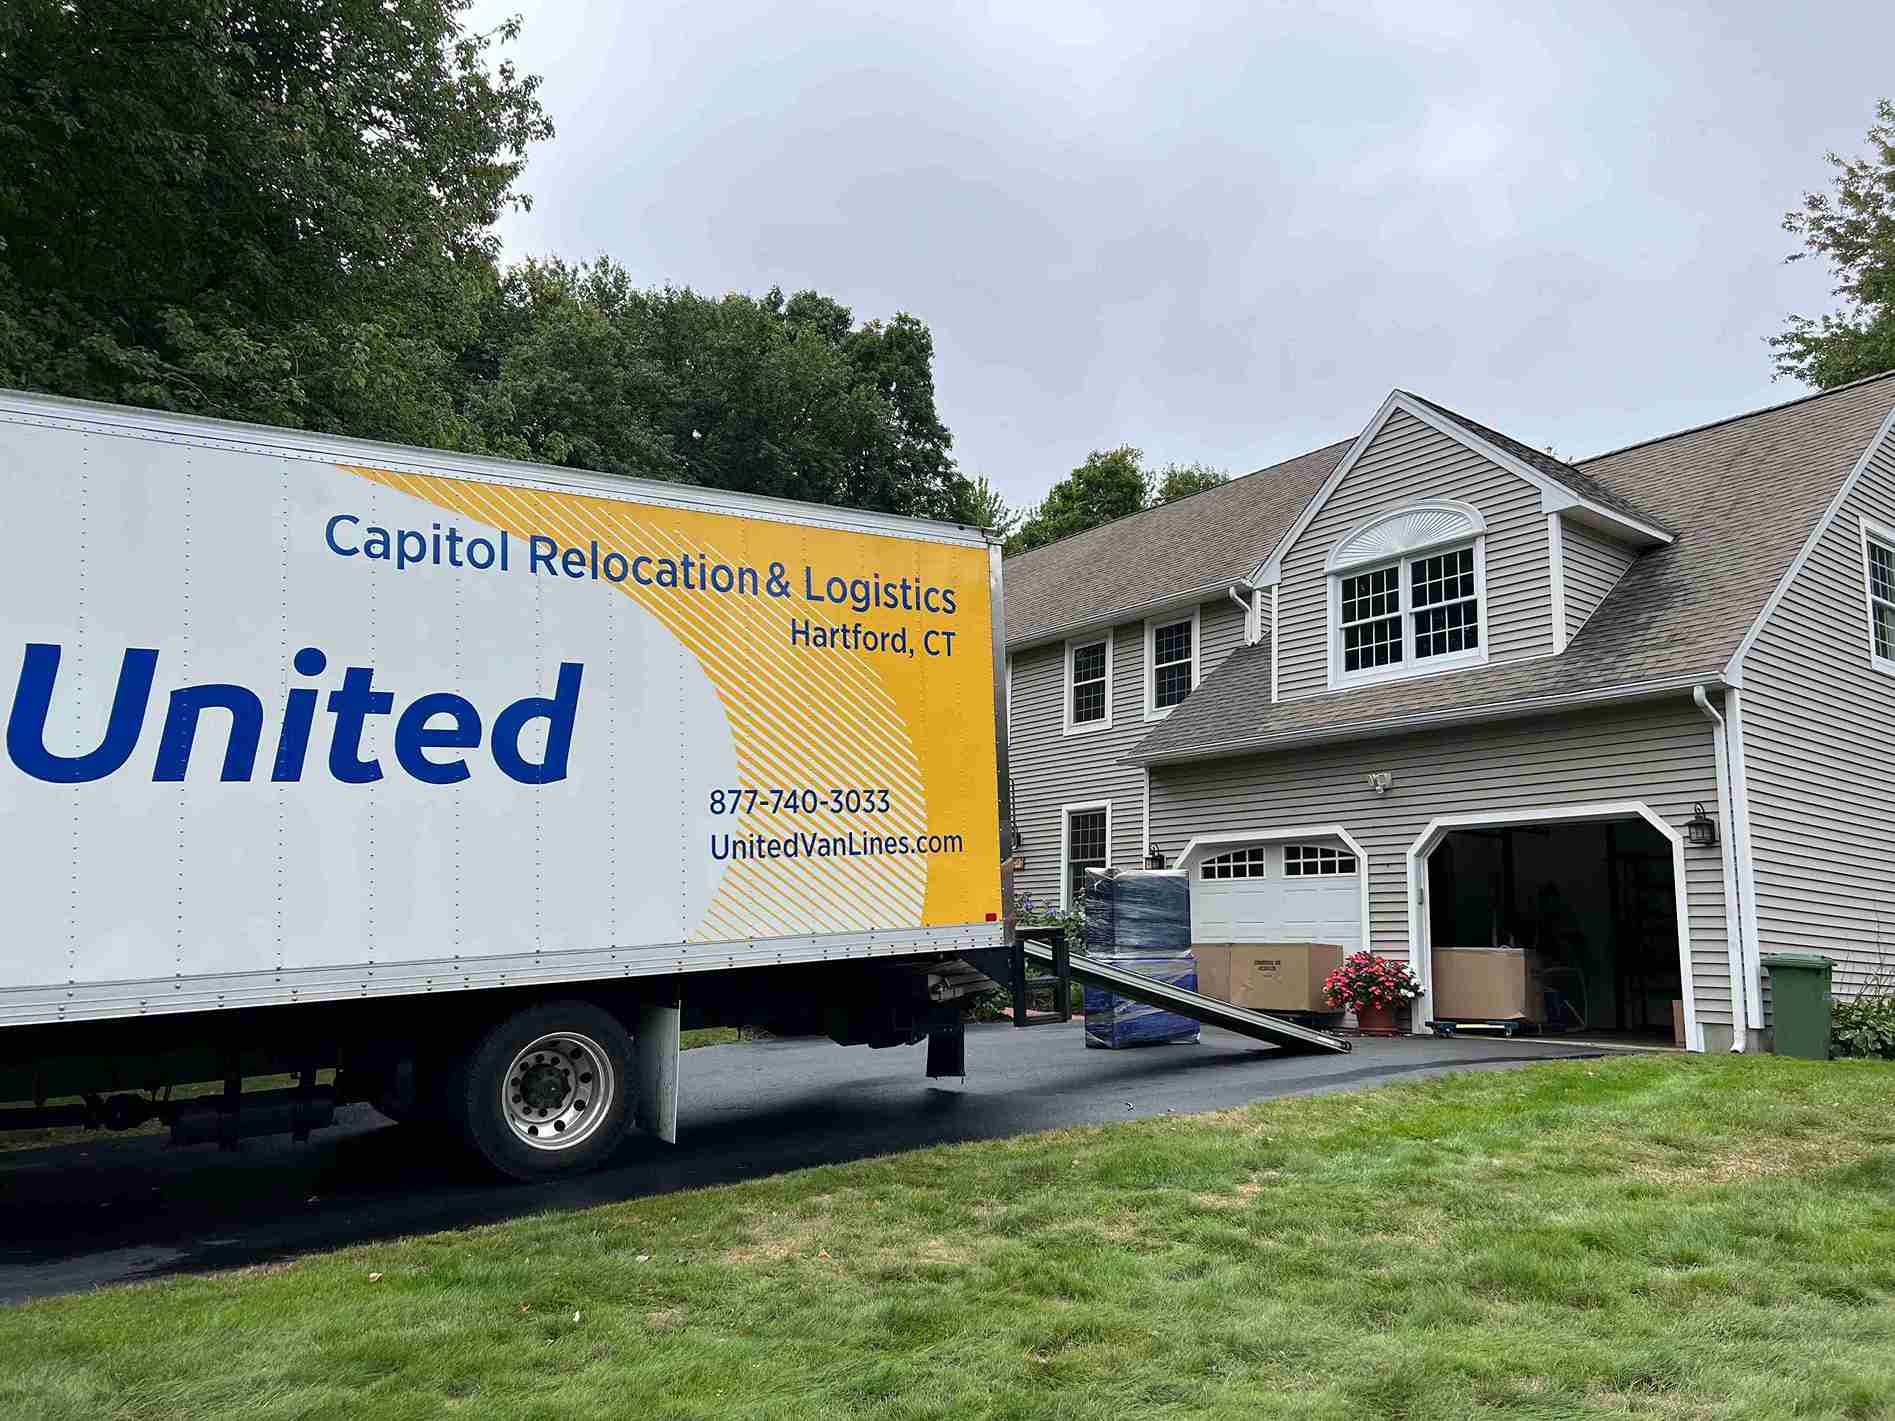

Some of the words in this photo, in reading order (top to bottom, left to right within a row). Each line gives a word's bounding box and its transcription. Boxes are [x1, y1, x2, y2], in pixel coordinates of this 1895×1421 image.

[325, 513, 509, 571] Capitol
[529, 534, 759, 597] Relocation
[804, 566, 957, 614] Logistics
[791, 619, 915, 657] Hartford,
[924, 630, 956, 657] CT
[6, 642, 585, 785] United
[710, 789, 890, 814] 877-740-3033
[711, 831, 963, 860] UnitedVanLines.com
